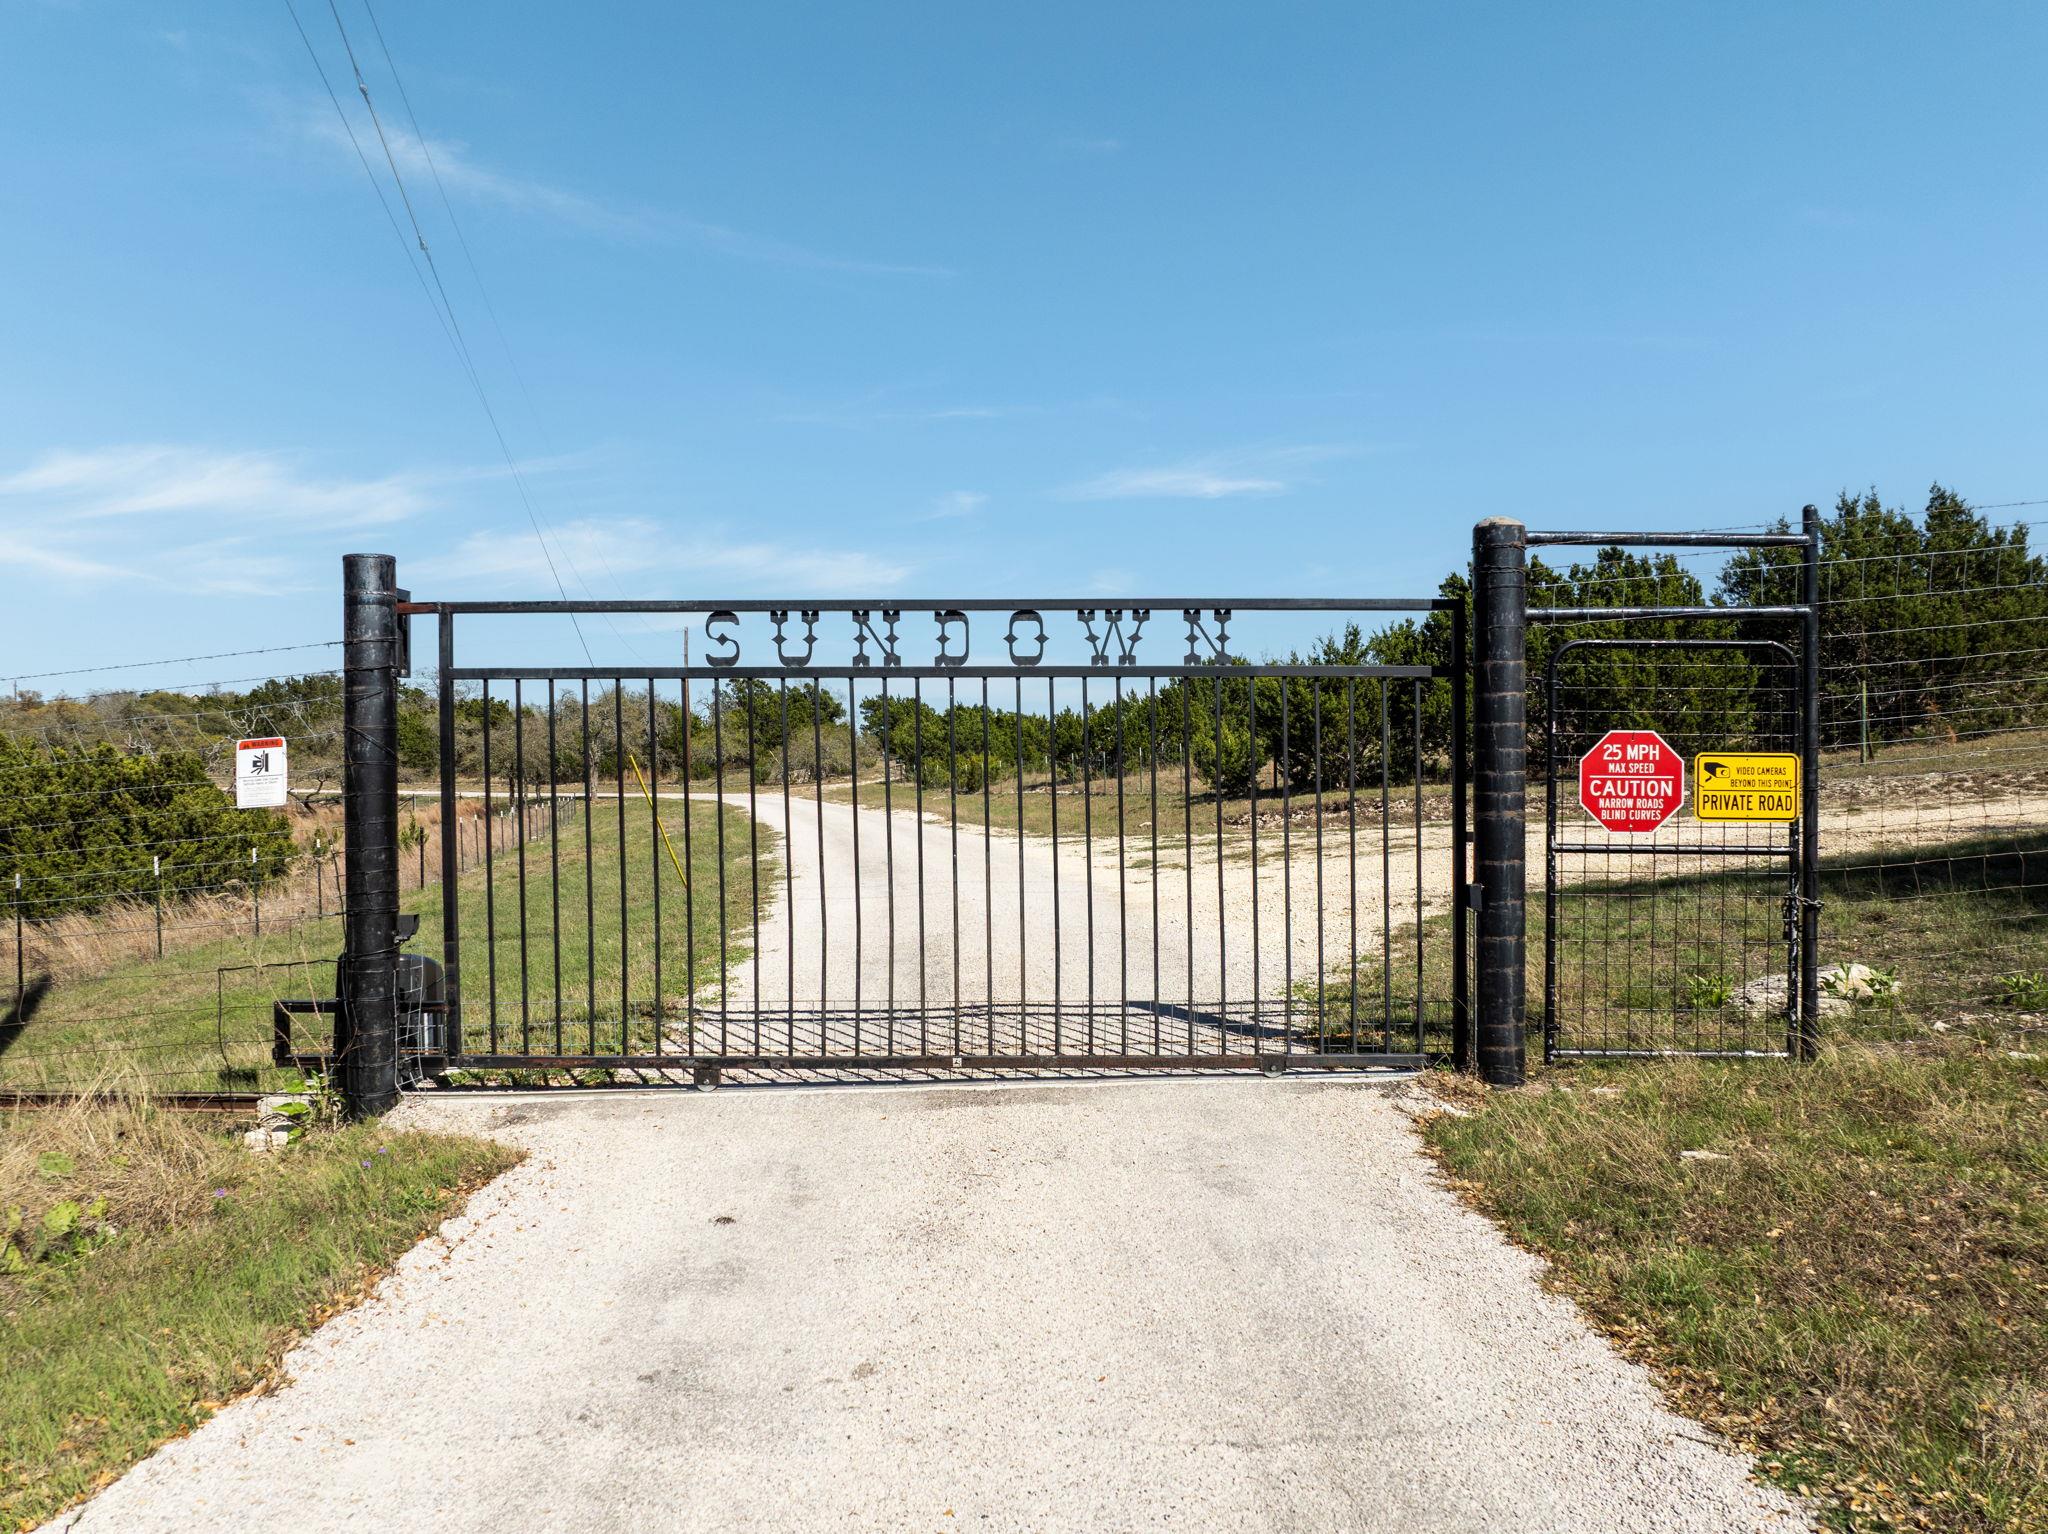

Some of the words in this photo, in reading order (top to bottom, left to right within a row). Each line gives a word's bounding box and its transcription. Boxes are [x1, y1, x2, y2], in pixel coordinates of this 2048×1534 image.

[705, 609, 1232, 667] SUNDOWN
[1603, 744, 1622, 760] 25
[1626, 744, 1659, 760] MPH
[1608, 763, 1626, 773] MAX
[1628, 763, 1655, 773] SPEED
[1736, 767, 1755, 775] VIDEO
[1757, 767, 1786, 776] CAMERAS
[1590, 780, 1673, 796] CAUTION
[1730, 779, 1756, 788] BEYOND
[1758, 779, 1772, 788] THIS
[1774, 779, 1793, 788] POINT
[1599, 798, 1634, 809] NARROW
[1636, 798, 1664, 809] ROADS
[1702, 795, 1753, 811] PRIVATE
[1758, 795, 1793, 812] ROAD
[1601, 809, 1626, 820] BLIND
[1629, 809, 1661, 820] CURVES
